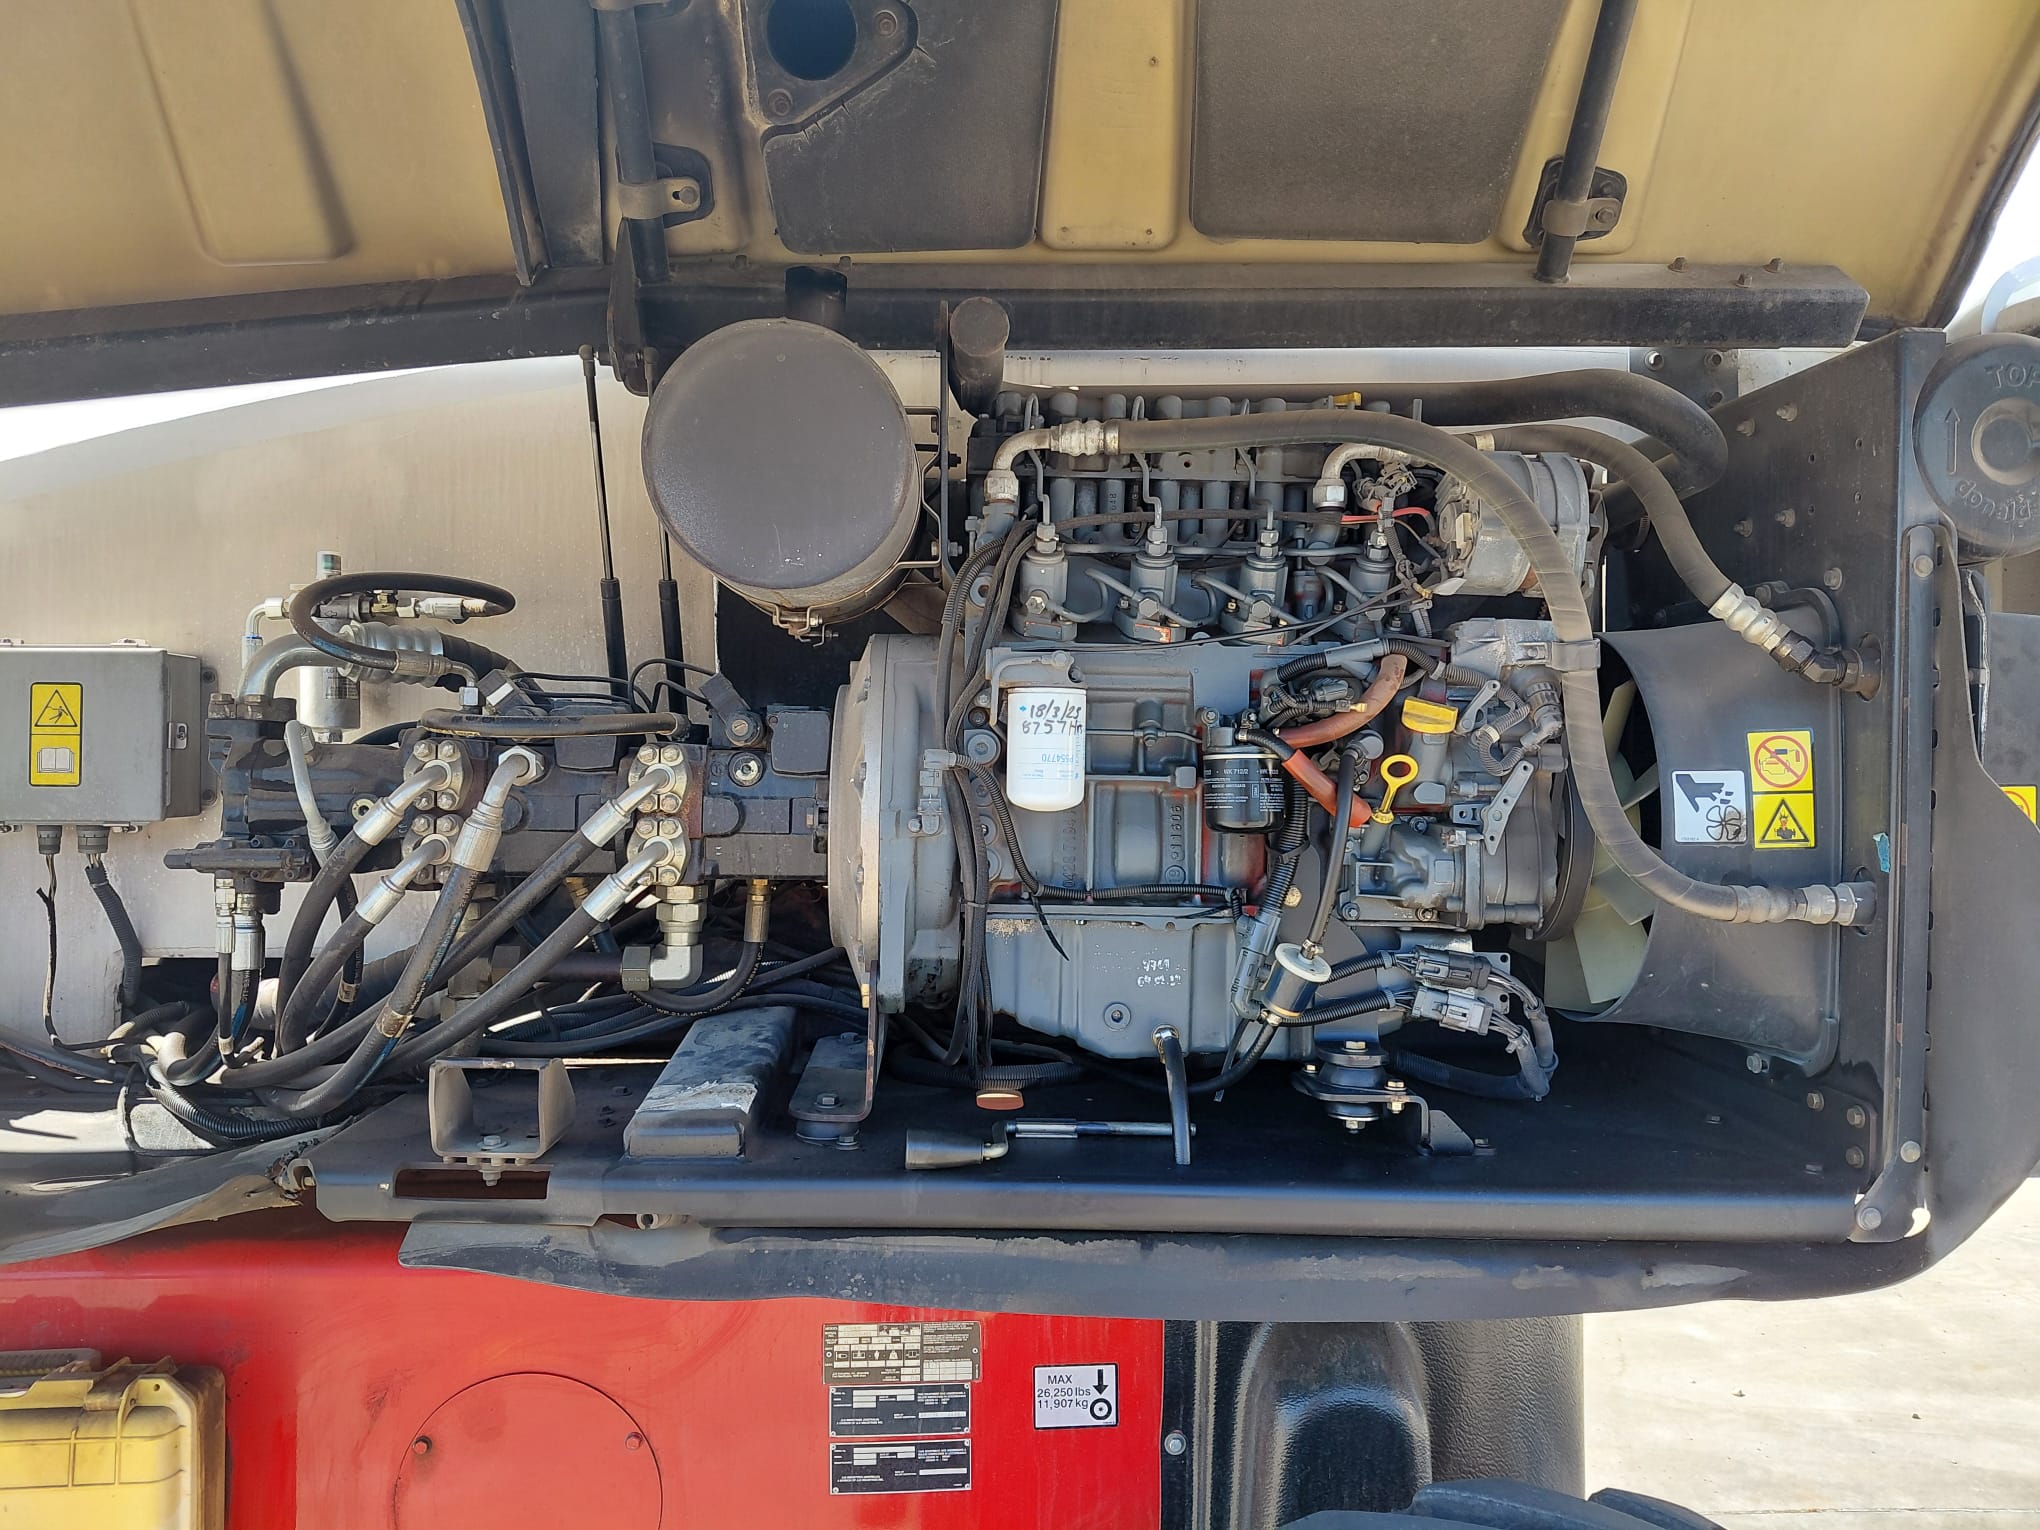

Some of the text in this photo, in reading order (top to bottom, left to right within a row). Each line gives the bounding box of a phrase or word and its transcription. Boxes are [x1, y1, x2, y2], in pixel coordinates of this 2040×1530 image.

[1047, 1374, 1073, 1385] MAX
[1037, 1386, 1091, 1399] 26,250 lbs
[1037, 1398, 1089, 1410] 11,907 kg
